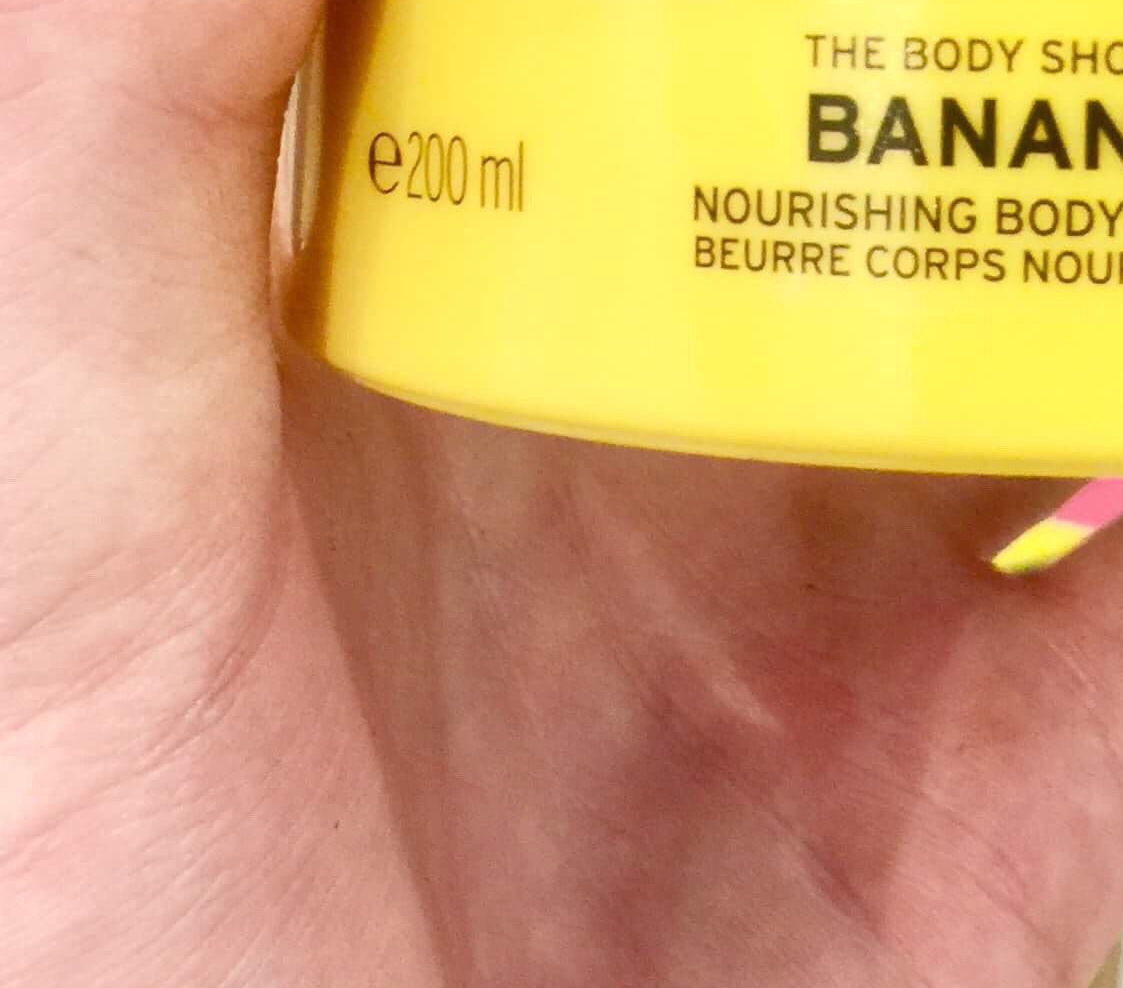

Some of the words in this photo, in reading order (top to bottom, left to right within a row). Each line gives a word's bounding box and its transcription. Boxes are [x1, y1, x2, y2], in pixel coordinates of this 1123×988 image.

[804, 34, 886, 71] THE
[902, 37, 1023, 74] BODY
[480, 140, 525, 212] ml
[692, 185, 978, 235] NOURISHING
[694, 237, 851, 277] BEURRE
[866, 245, 1005, 283] CORPS
